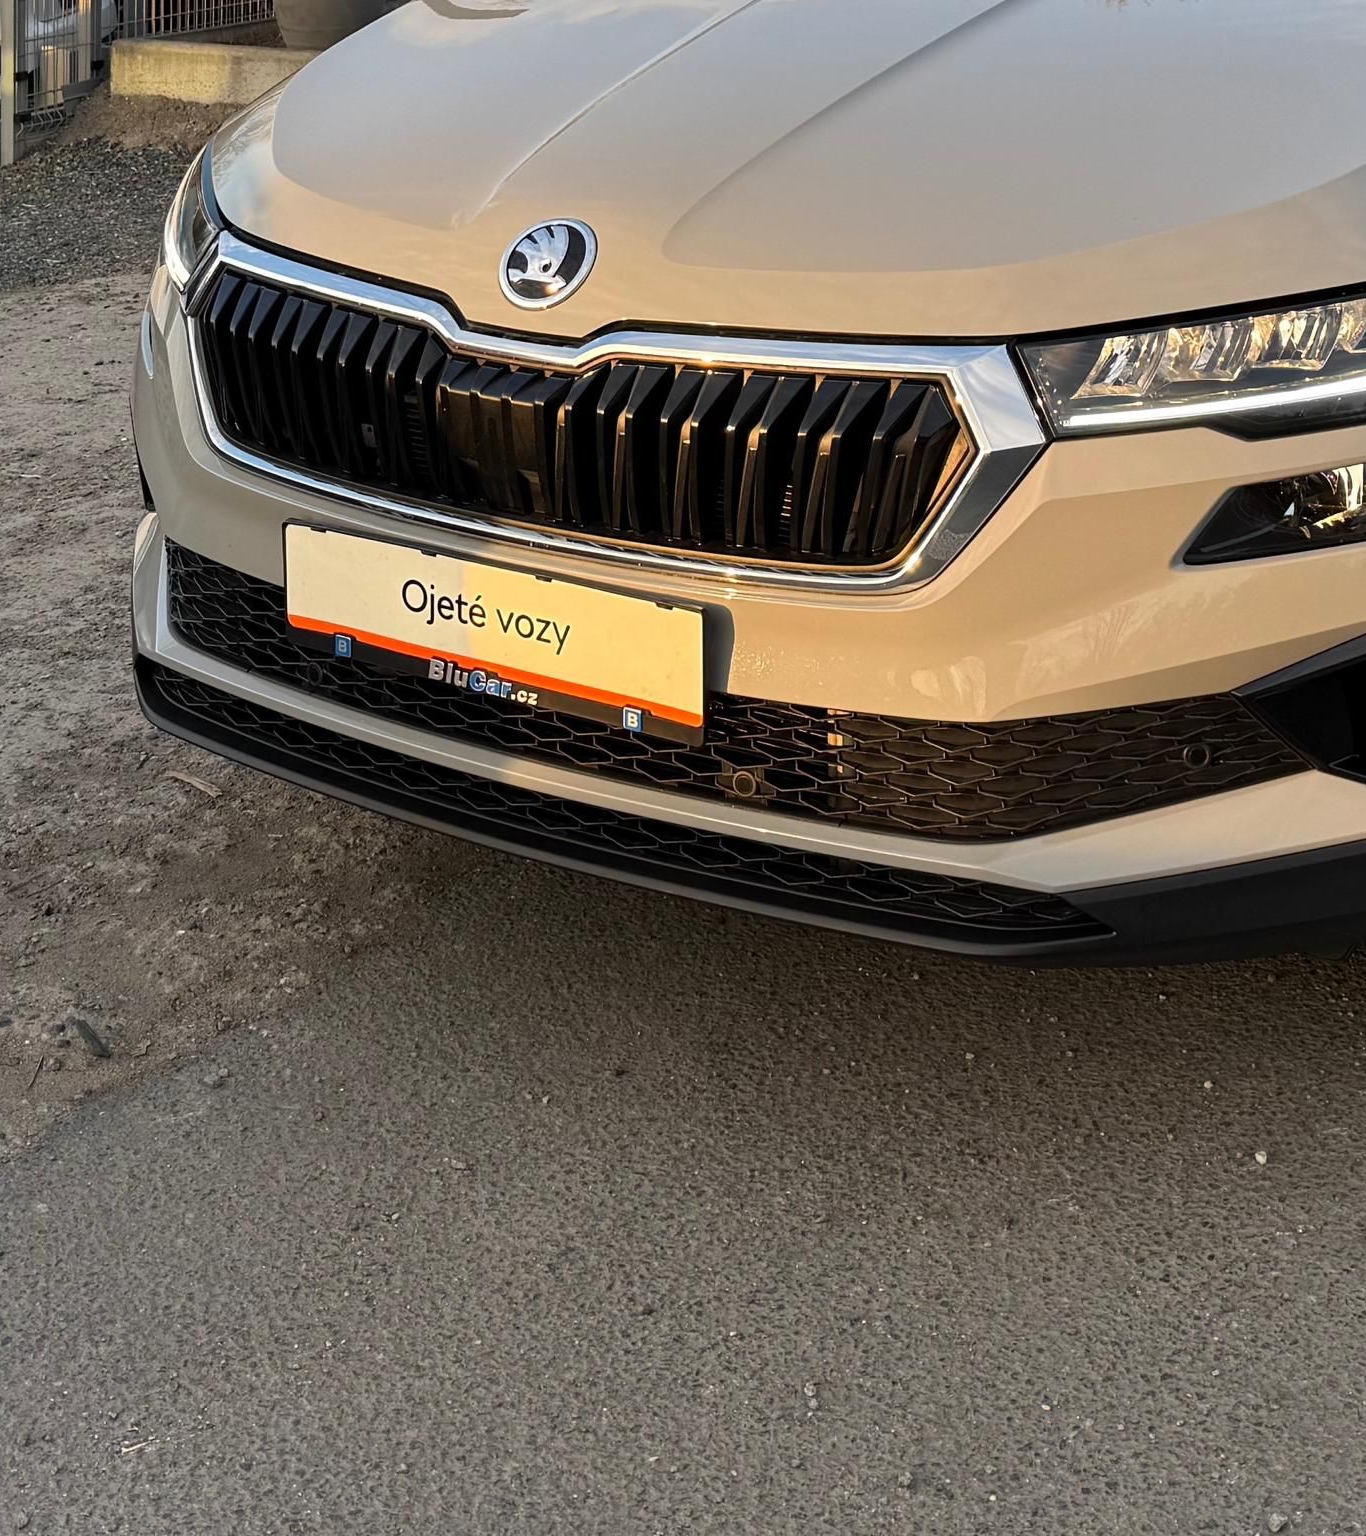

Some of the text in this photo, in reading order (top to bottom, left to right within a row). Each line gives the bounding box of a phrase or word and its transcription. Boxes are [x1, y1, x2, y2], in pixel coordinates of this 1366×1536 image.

[401, 579, 571, 655] Ojeté vozy
[427, 657, 539, 706] BluCar.cz
[627, 711, 639, 729] B
